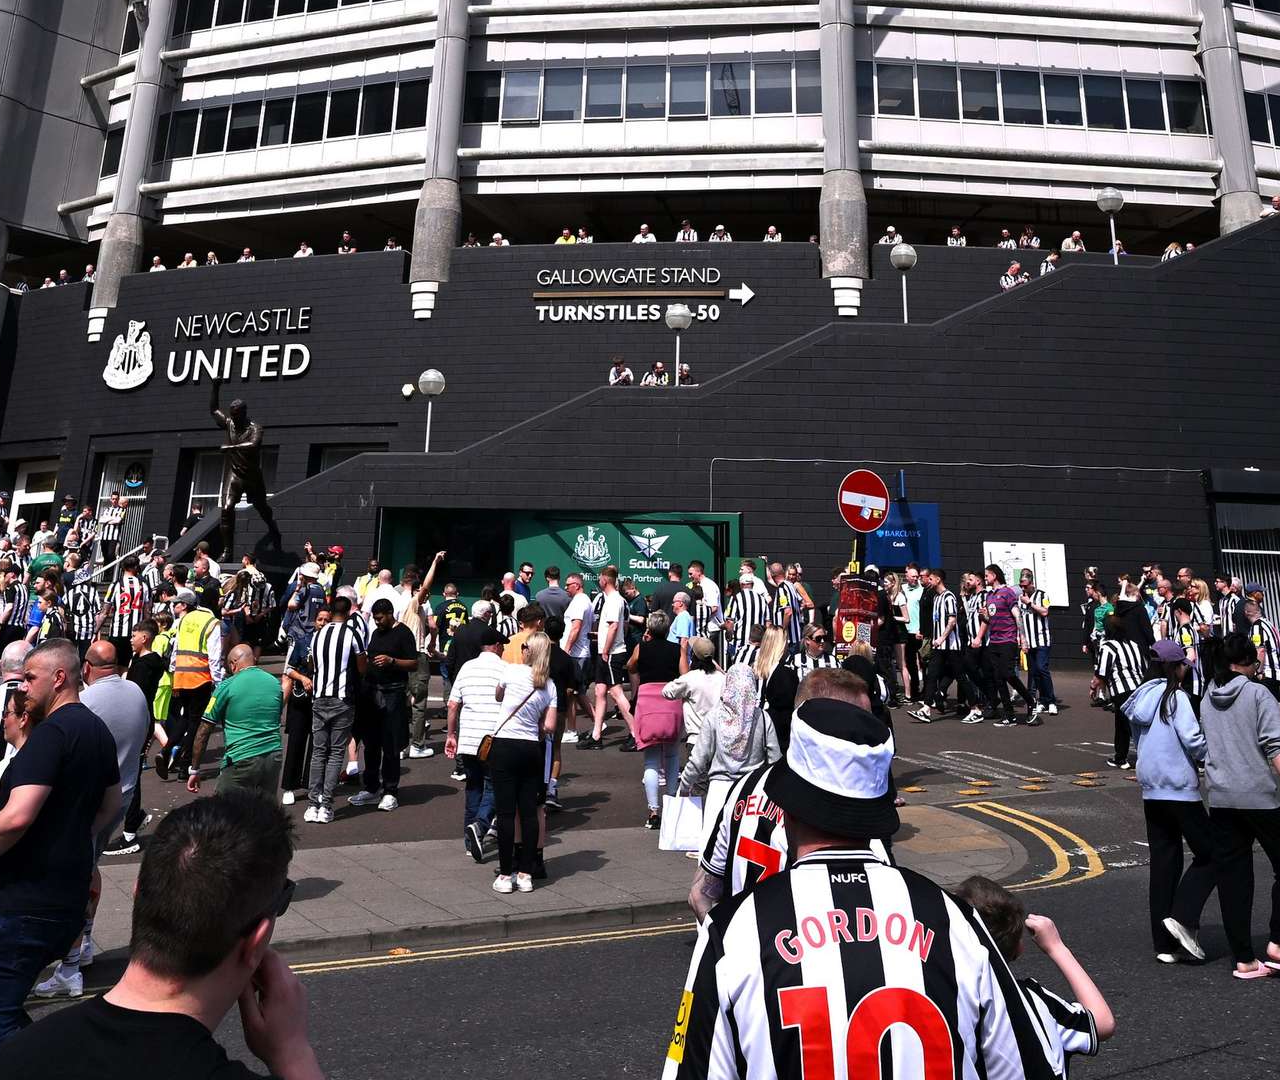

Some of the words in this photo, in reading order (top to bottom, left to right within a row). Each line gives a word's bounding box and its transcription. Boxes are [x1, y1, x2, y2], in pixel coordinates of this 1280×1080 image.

[536, 268, 657, 286] GALLOWGATE
[660, 267, 721, 284] STAND
[174, 306, 312, 338] NEWCASTLE
[535, 304, 661, 321] TURNSTILES
[167, 343, 311, 383] UNITED
[884, 530, 921, 538] BARCLAYS
[629, 557, 671, 570] Saudia
[633, 573, 664, 583] Partner
[119, 591, 144, 615] 24
[831, 872, 868, 884] NUFC
[774, 907, 935, 965] GORDON
[777, 985, 955, 1080] 10
